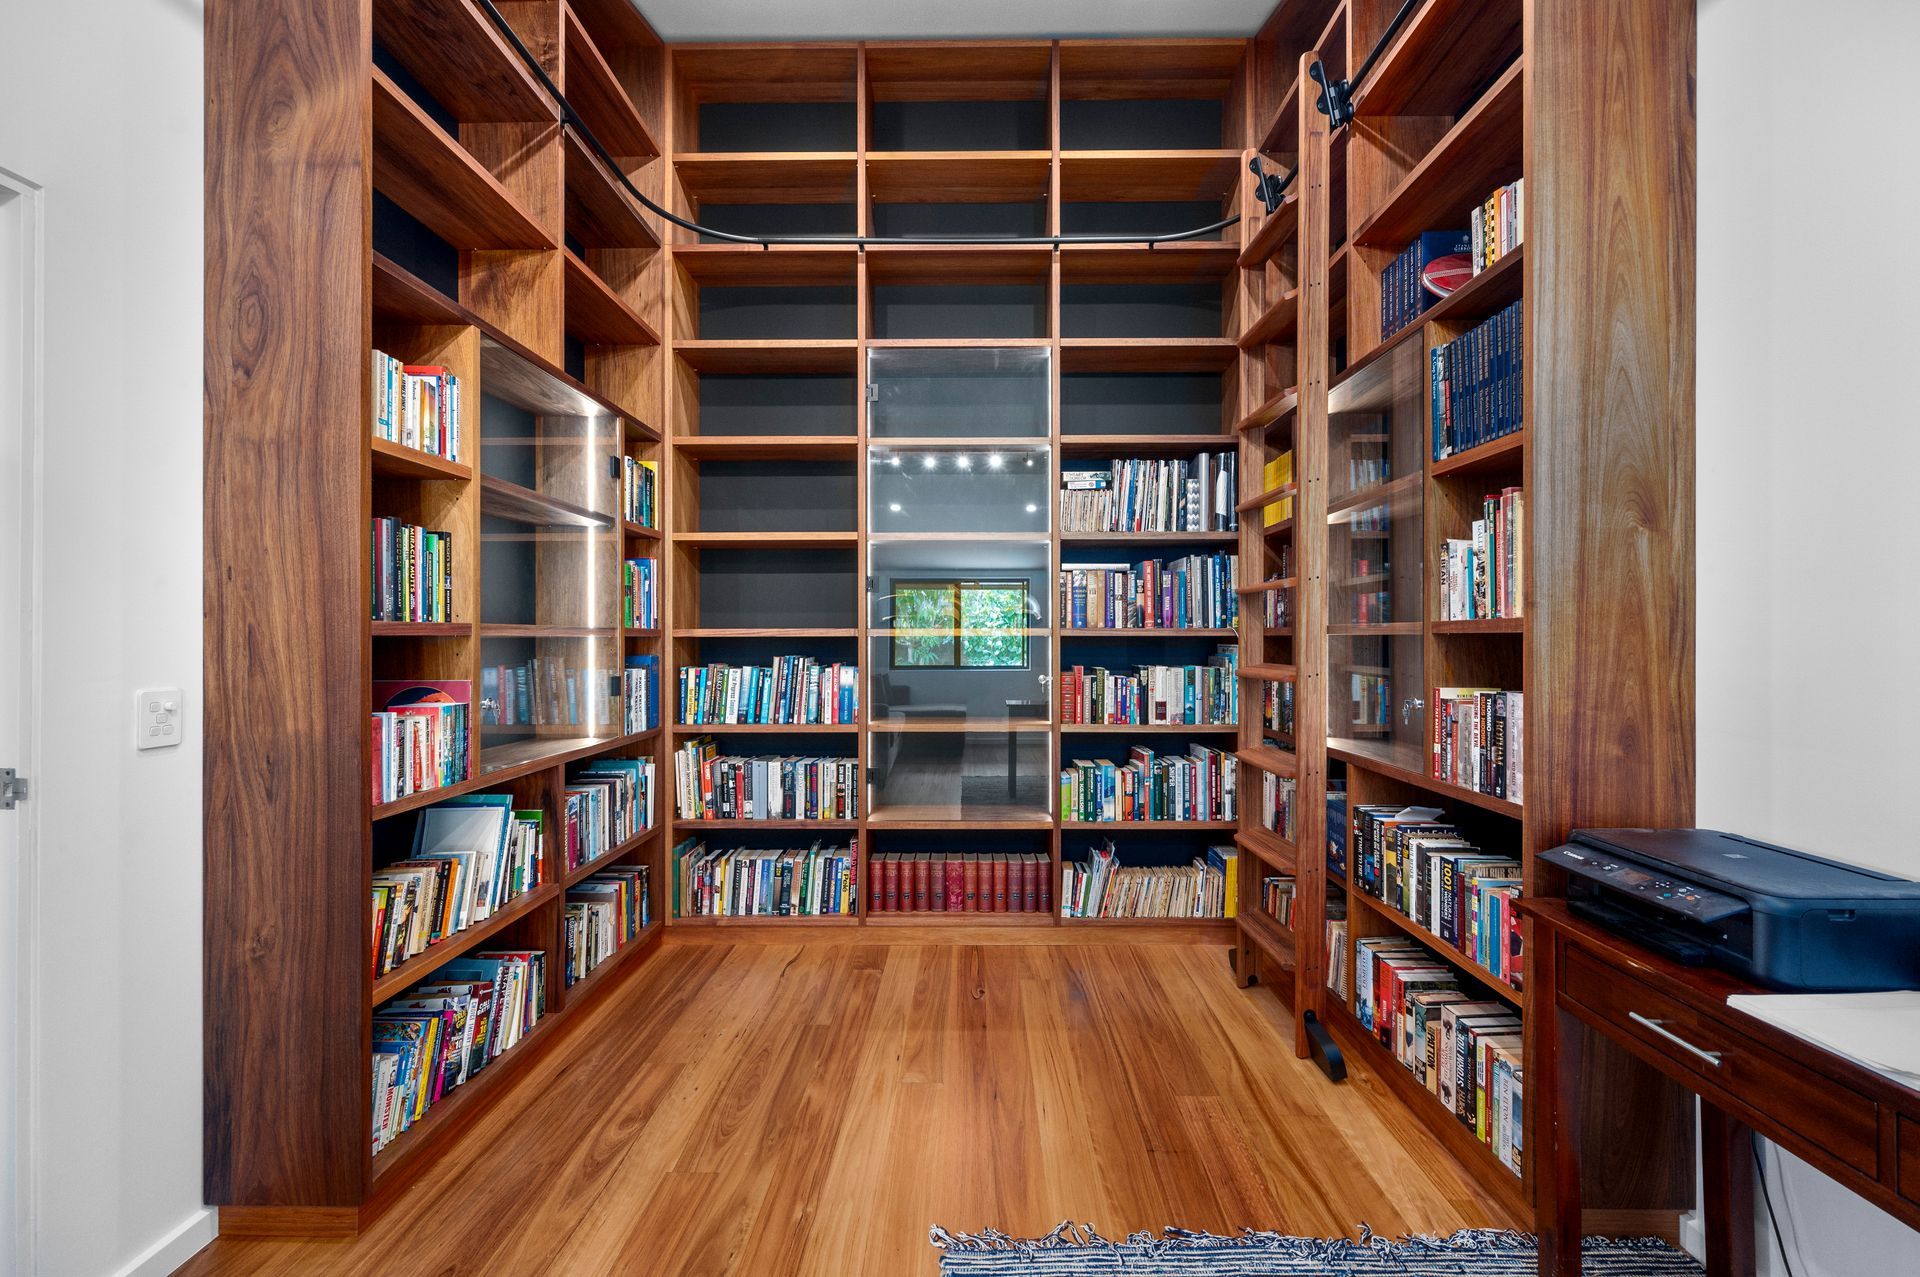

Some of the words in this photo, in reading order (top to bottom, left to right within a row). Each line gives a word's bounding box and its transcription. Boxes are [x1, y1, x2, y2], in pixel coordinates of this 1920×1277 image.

[1444, 862, 1452, 890] 1001
[495, 967, 503, 990] GOLF
[1427, 1033, 1436, 1071] PATTON
[1456, 1032, 1465, 1053] TIDE
[1456, 1053, 1465, 1087] STORM
[382, 1088, 394, 1130] MONSTER
